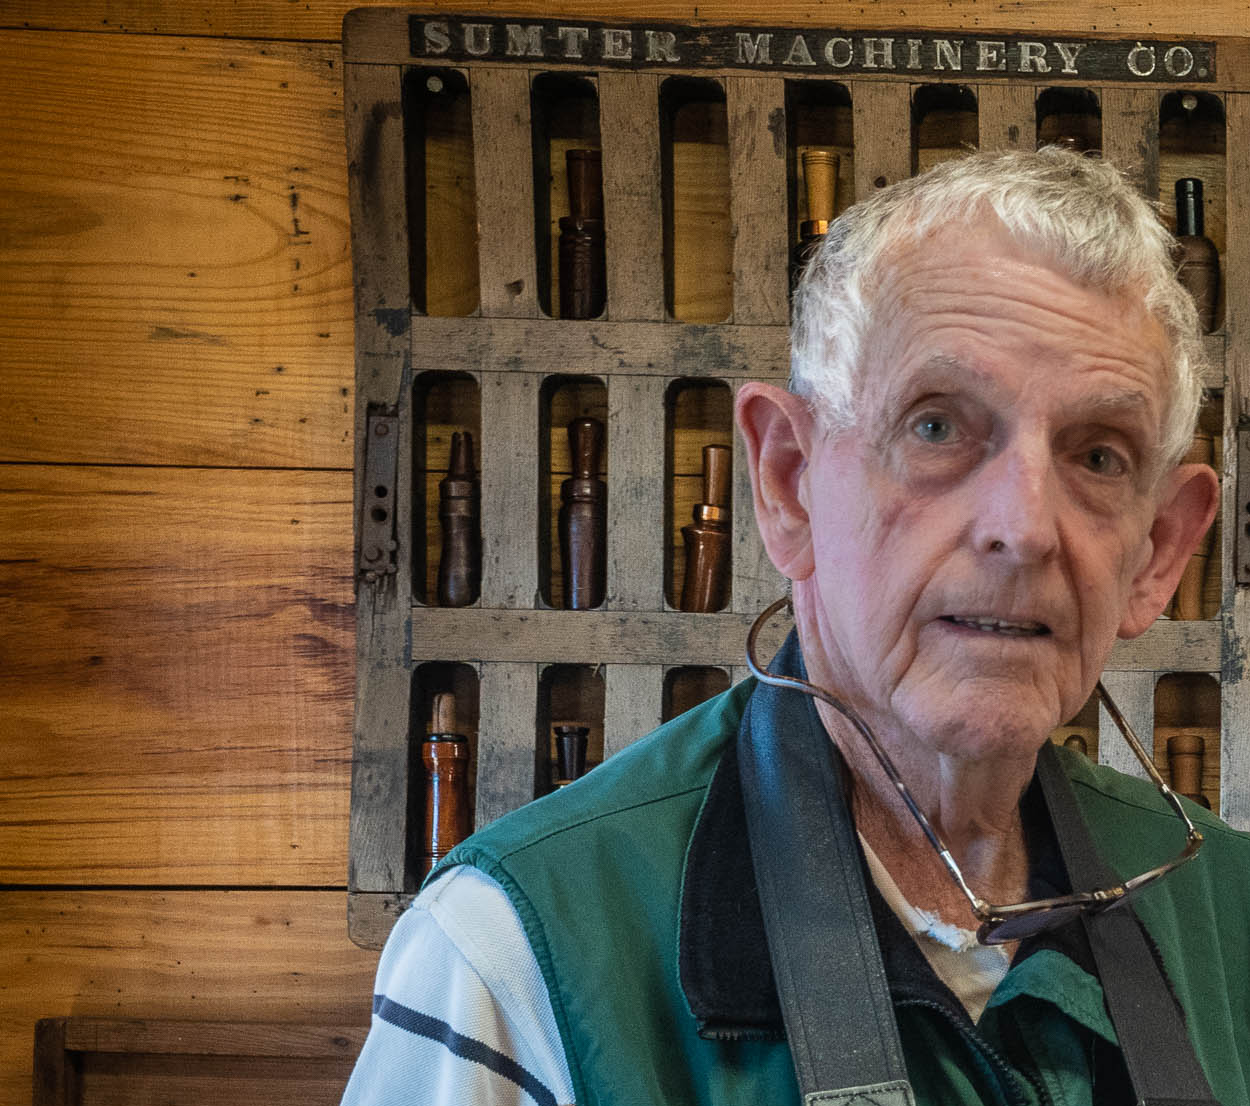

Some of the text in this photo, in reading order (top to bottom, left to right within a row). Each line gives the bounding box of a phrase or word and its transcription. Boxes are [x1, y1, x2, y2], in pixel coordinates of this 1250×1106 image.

[422, 20, 1210, 79] SUMTER MACHINERY CO.
